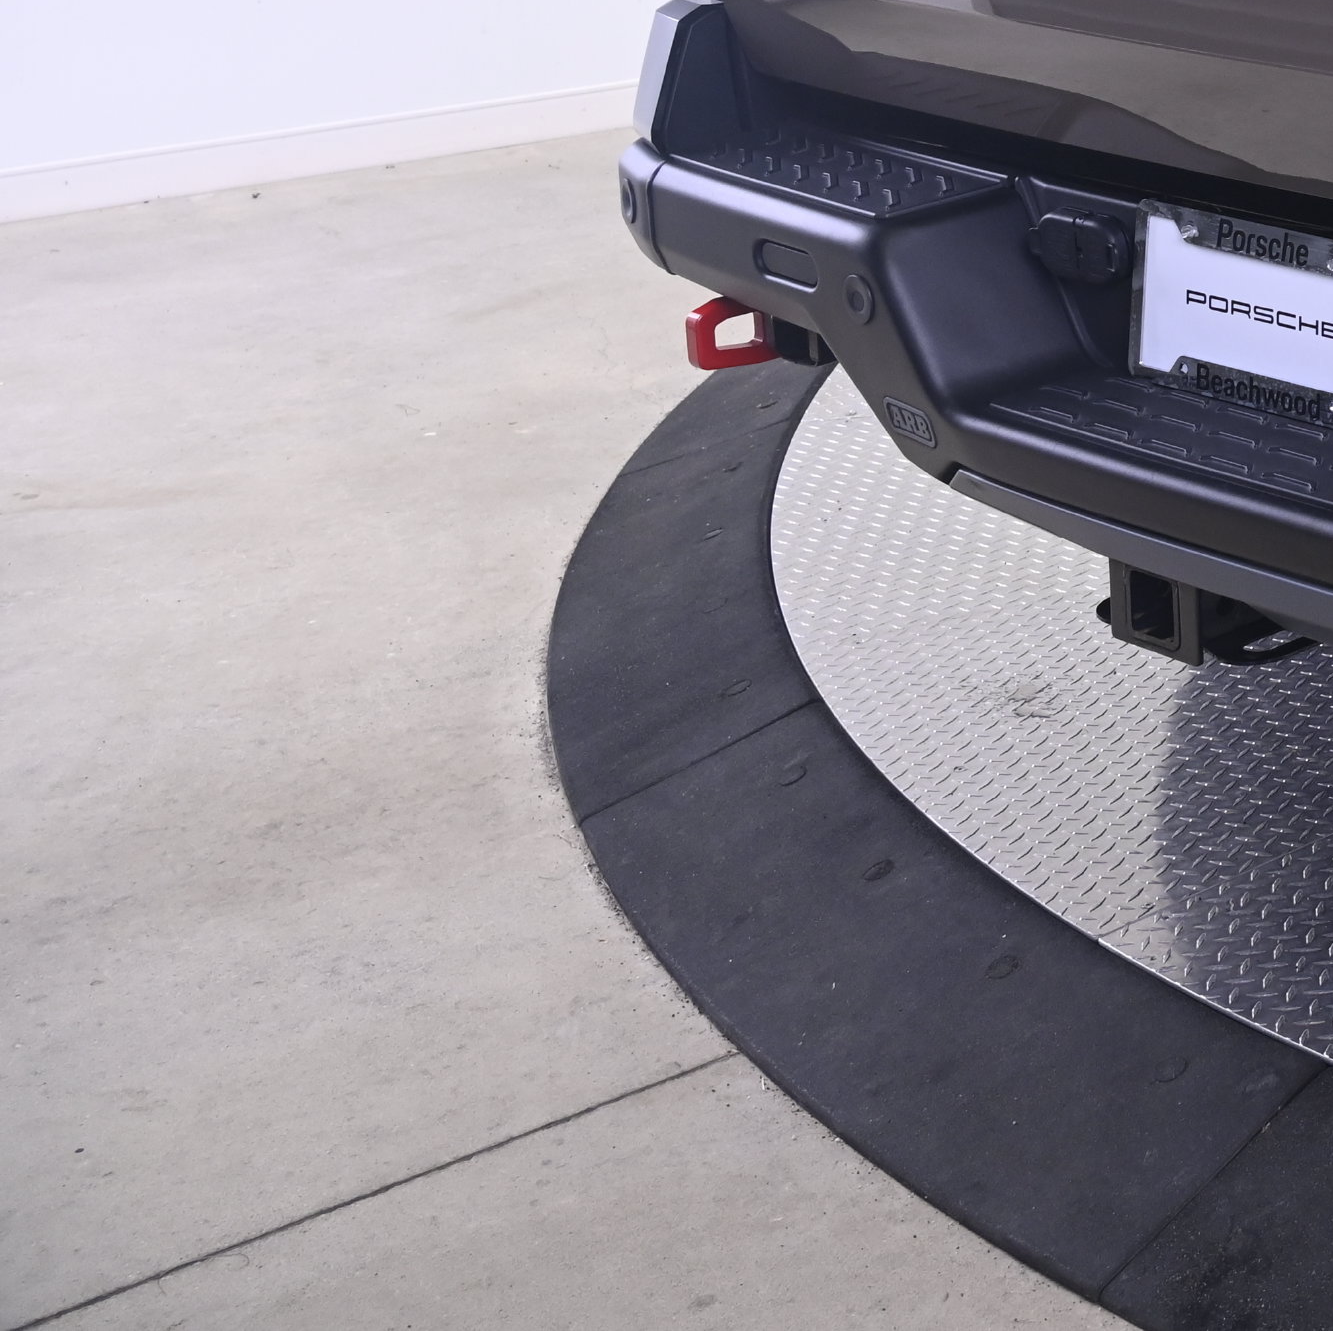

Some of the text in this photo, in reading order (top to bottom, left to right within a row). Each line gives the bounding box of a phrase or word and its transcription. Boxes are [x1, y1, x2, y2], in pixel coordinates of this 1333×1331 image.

[1217, 218, 1309, 267] Porsche
[1196, 363, 1321, 420] Beachwood
[889, 405, 931, 441] ARB
